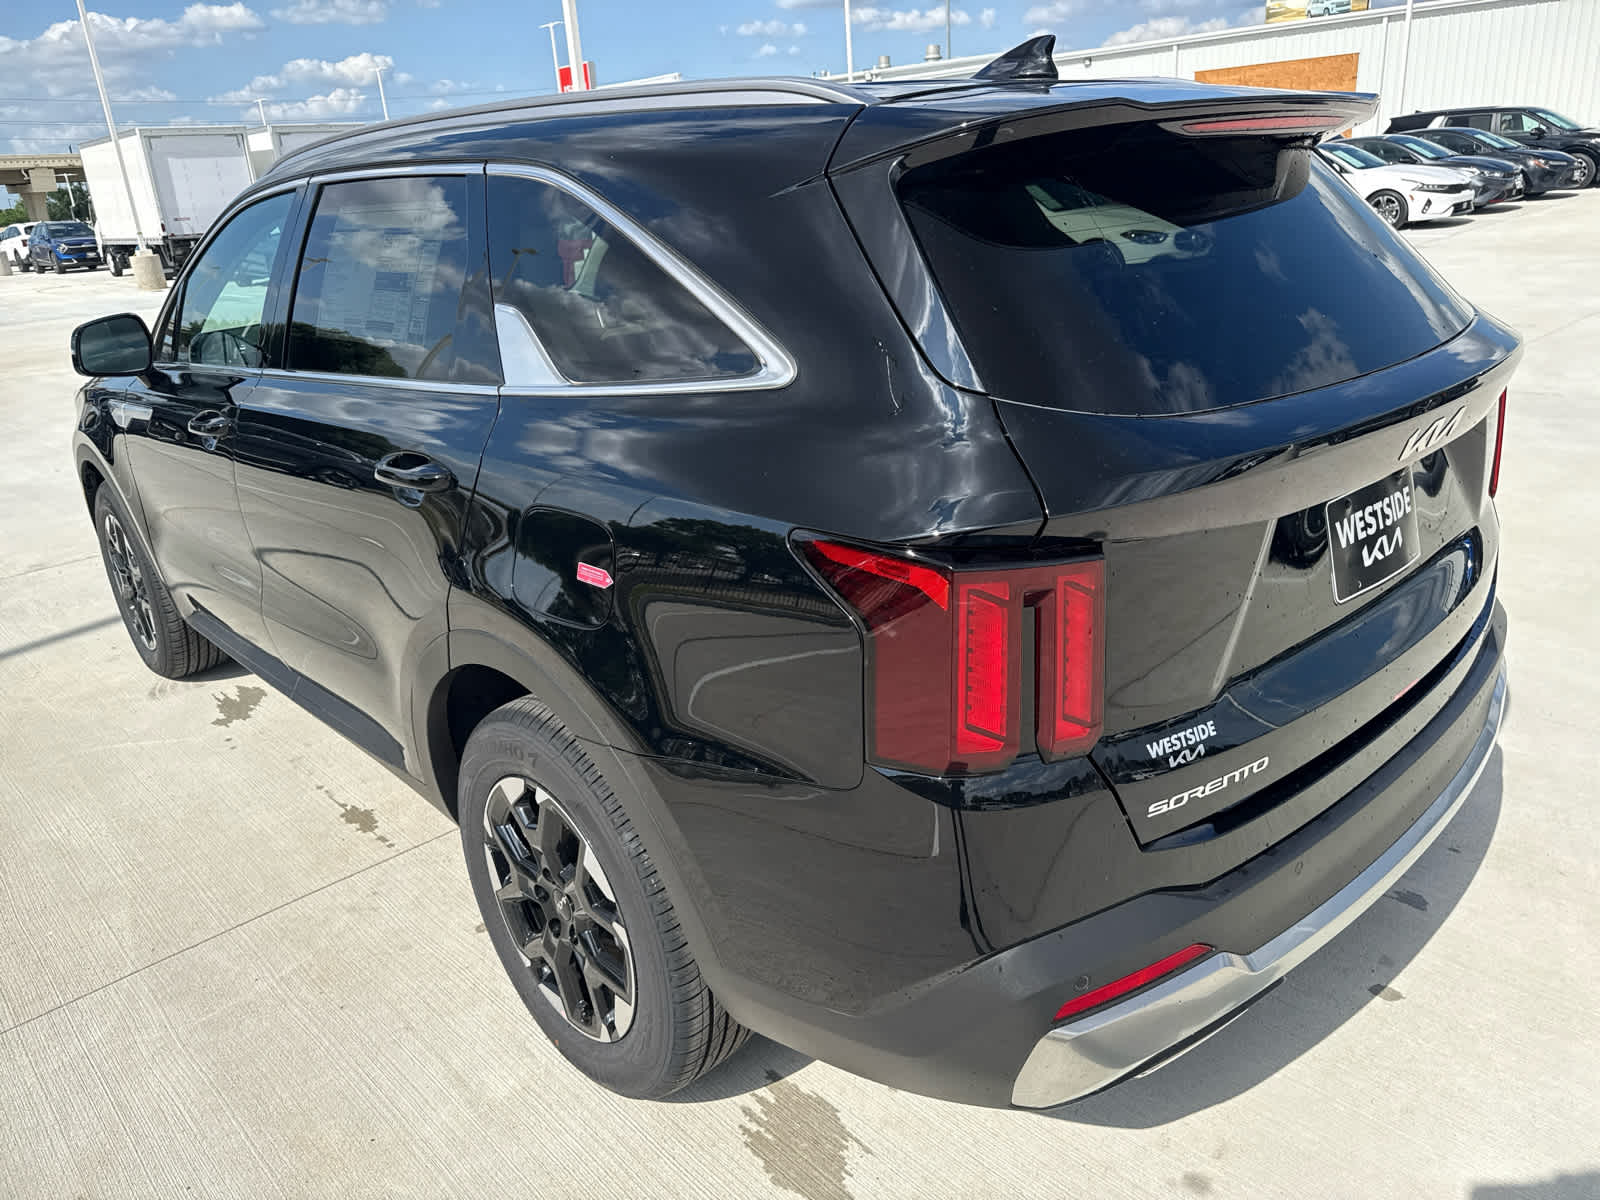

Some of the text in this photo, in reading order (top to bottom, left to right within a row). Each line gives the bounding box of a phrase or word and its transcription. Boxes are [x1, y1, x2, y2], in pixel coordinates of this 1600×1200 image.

[1335, 486, 1412, 549] WESTSIDE
[1361, 526, 1403, 567] KIA
[1146, 720, 1217, 759] WESTSIDE
[1168, 743, 1206, 768] KIA
[1146, 756, 1269, 818] SORENTO
